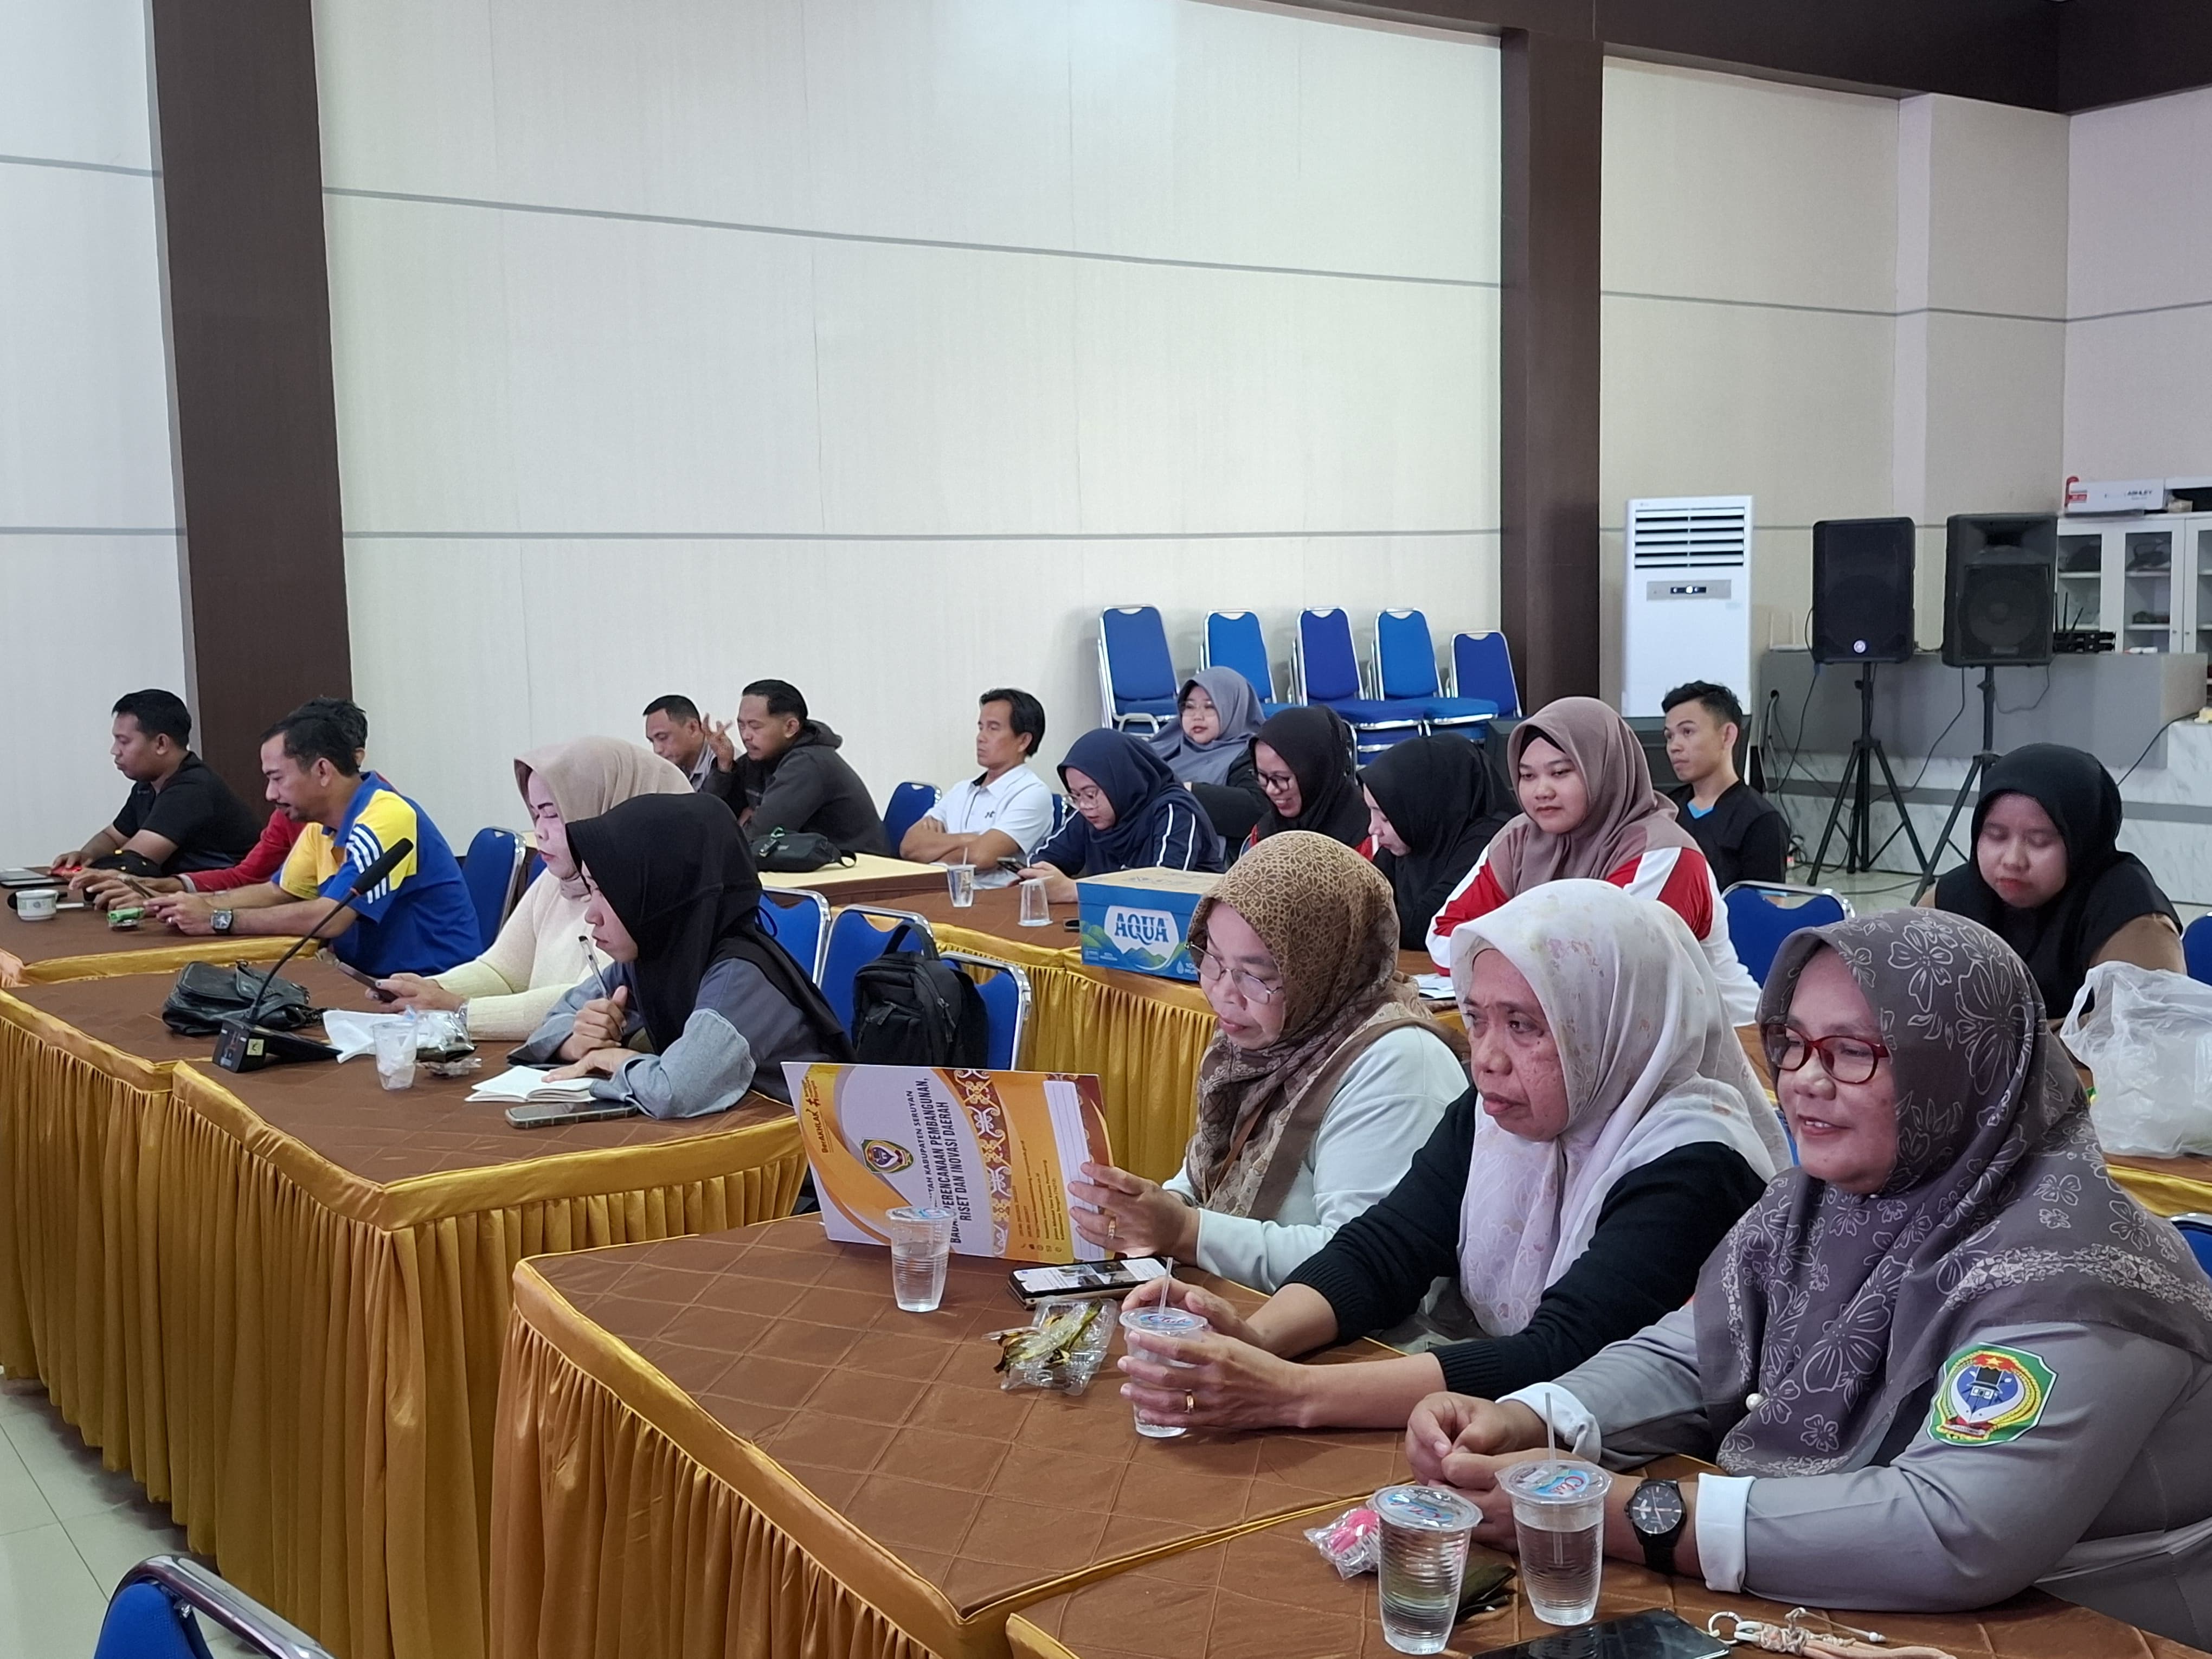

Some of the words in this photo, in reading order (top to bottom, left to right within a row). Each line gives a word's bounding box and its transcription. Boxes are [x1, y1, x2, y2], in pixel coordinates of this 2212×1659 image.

[1115, 912, 1169, 946] AQUA
[905, 1090, 921, 1127] SERUYAN
[915, 1078, 943, 1146] PEMBANGUNAN,
[936, 1102, 956, 1136] DAERAH
[915, 1128, 932, 1175] KABUPATEN
[944, 1139, 963, 1173] INOVASI
[952, 1175, 967, 1193] DAN
[956, 1195, 972, 1221] RISET
